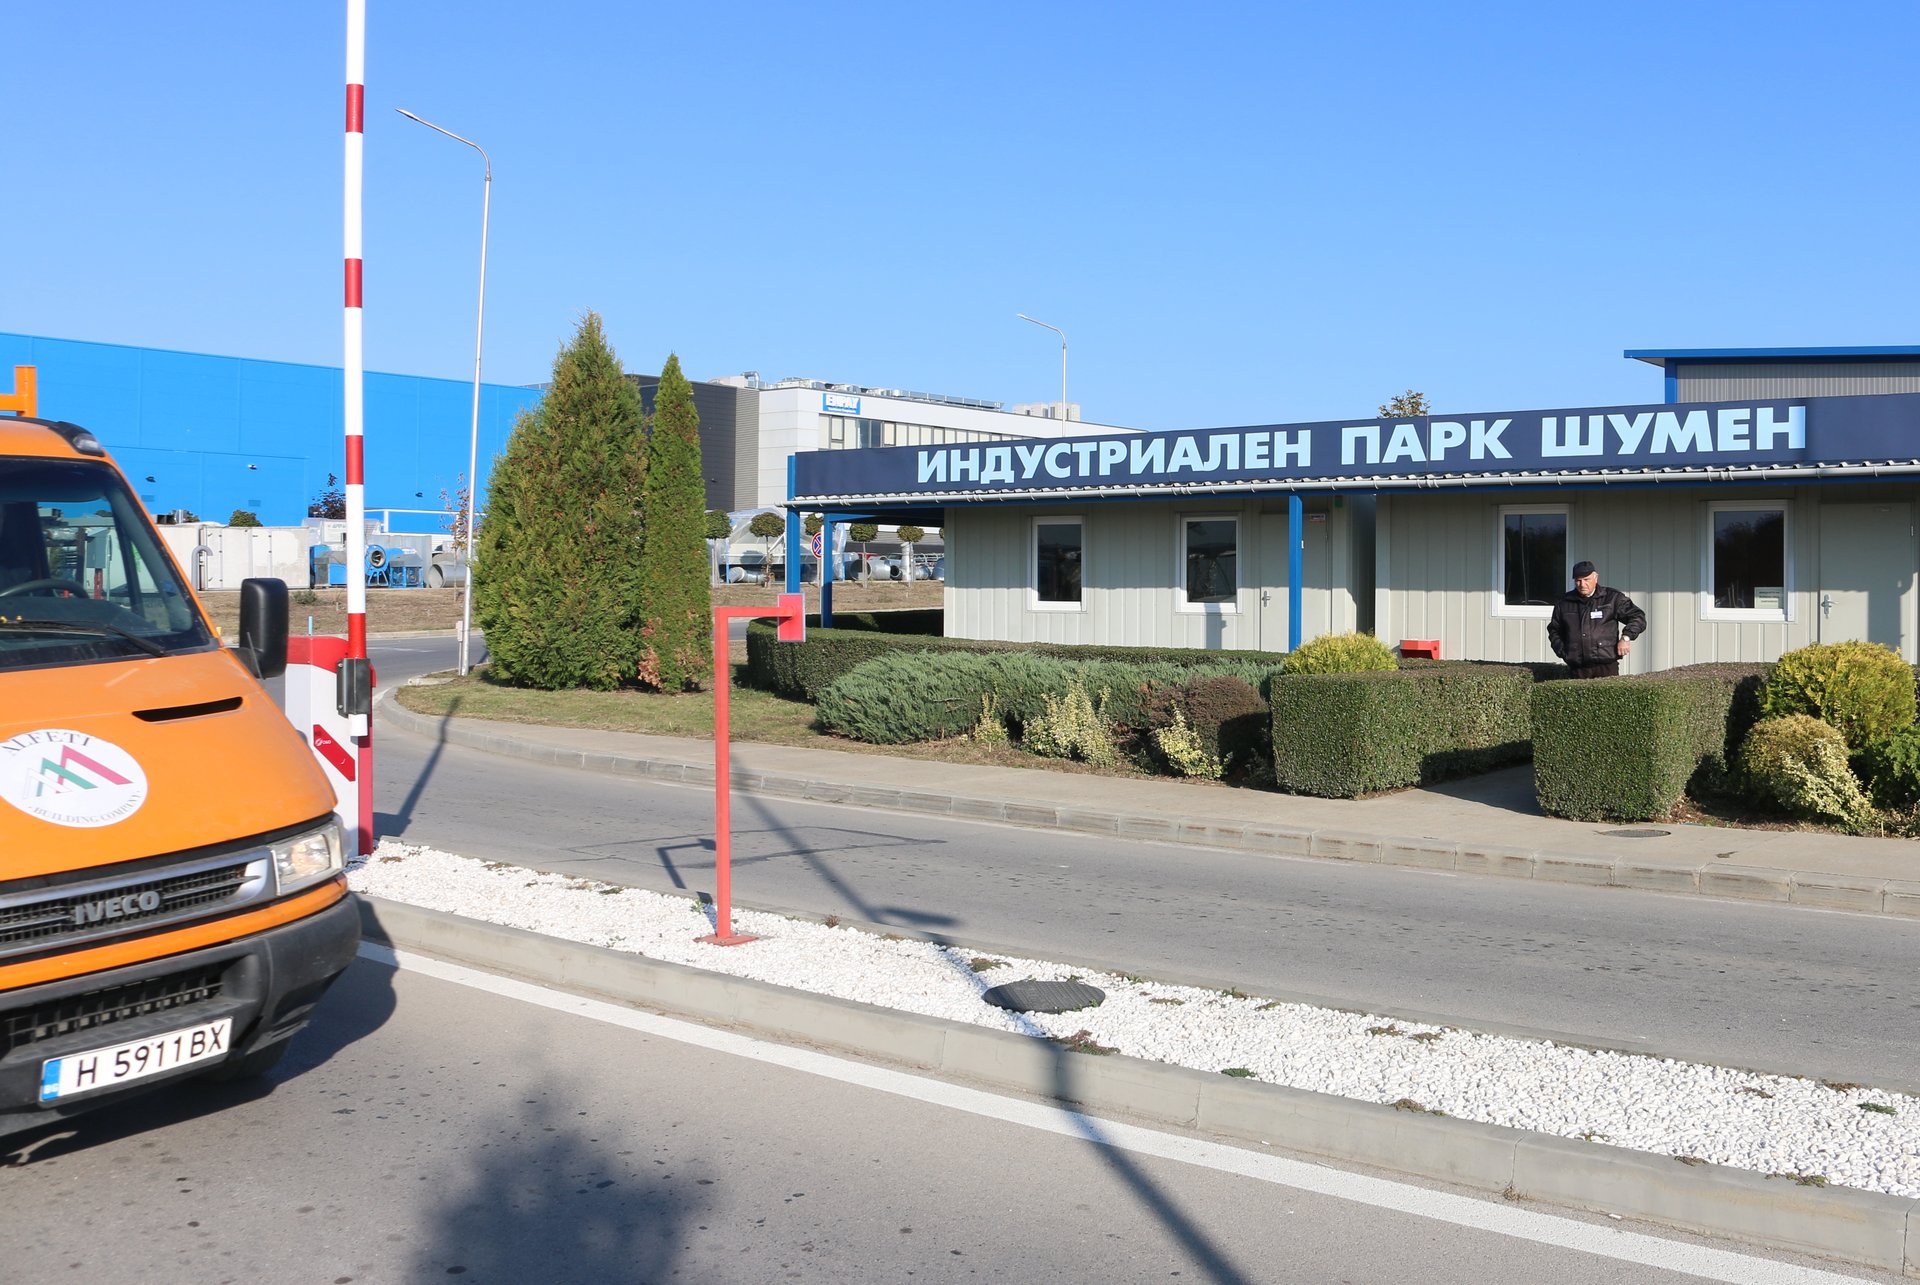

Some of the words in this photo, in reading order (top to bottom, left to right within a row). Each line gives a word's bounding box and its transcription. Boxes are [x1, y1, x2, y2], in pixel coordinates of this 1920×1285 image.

[917, 429, 1312, 484] ИНДУСТРИАЛЕН
[1341, 418, 1513, 466] ПАРК
[1540, 405, 1807, 458] ШУМЕН
[33, 807, 99, 824] BUILDING
[74, 890, 160, 925] IVECO
